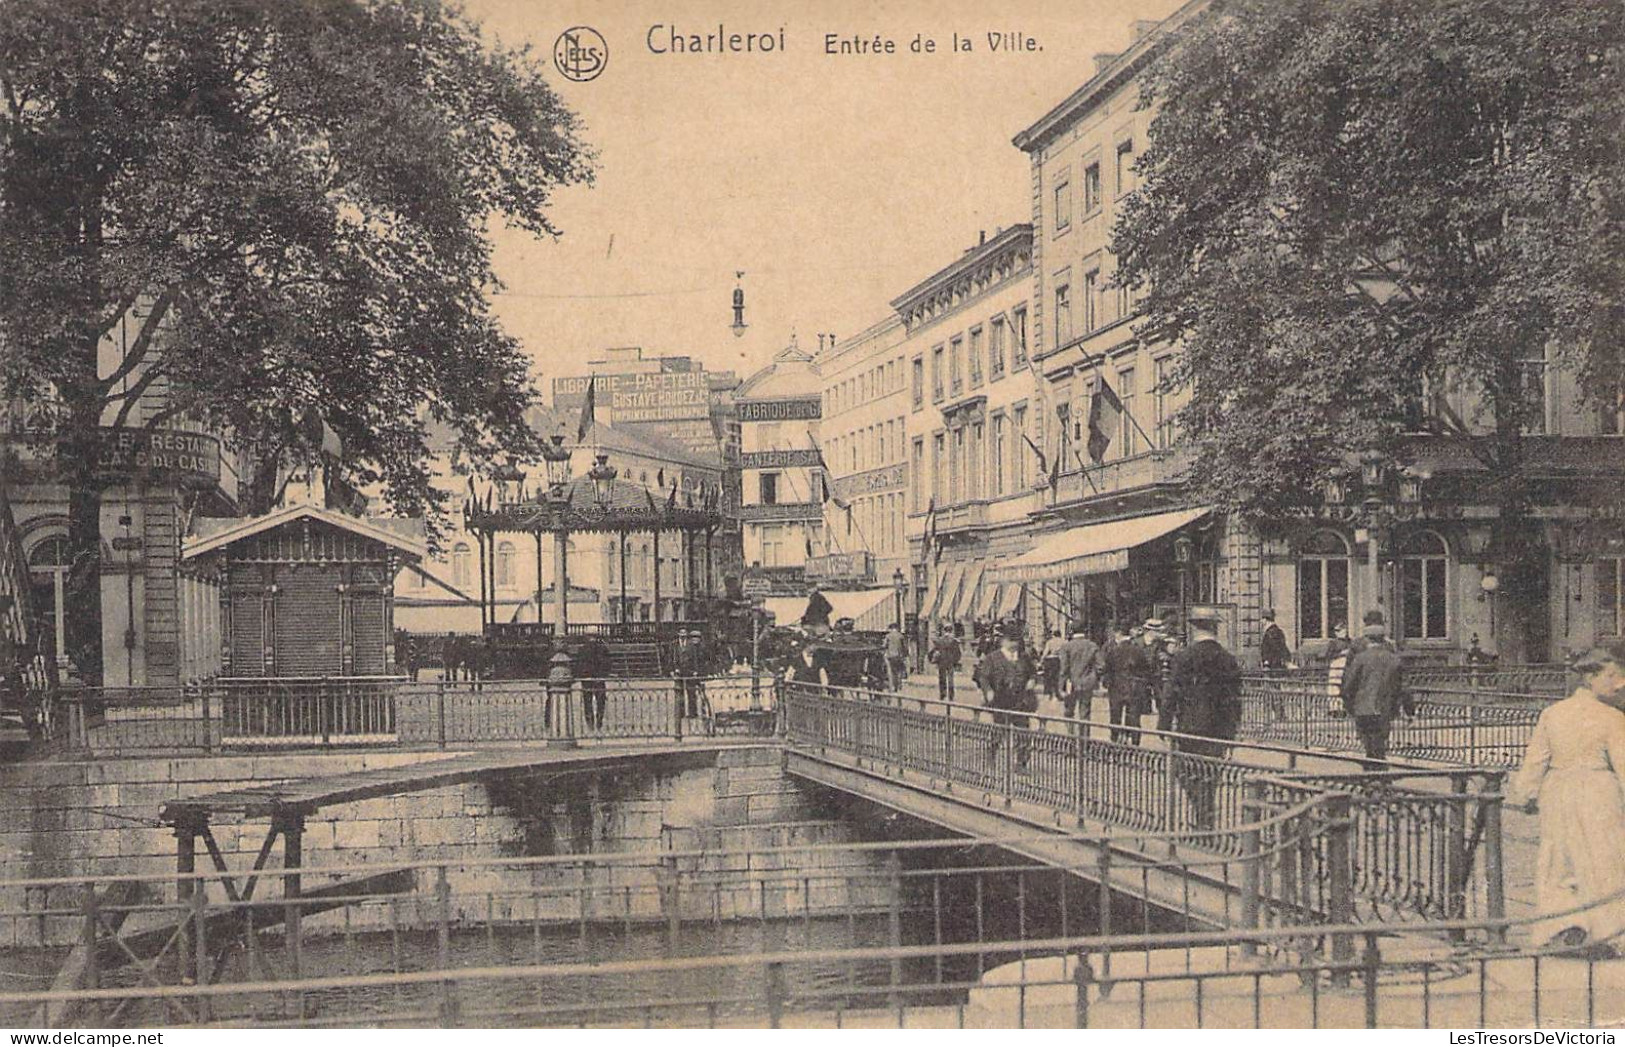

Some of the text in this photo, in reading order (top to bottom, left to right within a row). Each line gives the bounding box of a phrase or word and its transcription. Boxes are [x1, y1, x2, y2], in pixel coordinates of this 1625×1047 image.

[635, 371, 709, 391] PAPETERIE
[612, 391, 657, 408] GUSTAVE
[740, 402, 793, 419] FABRIQUE
